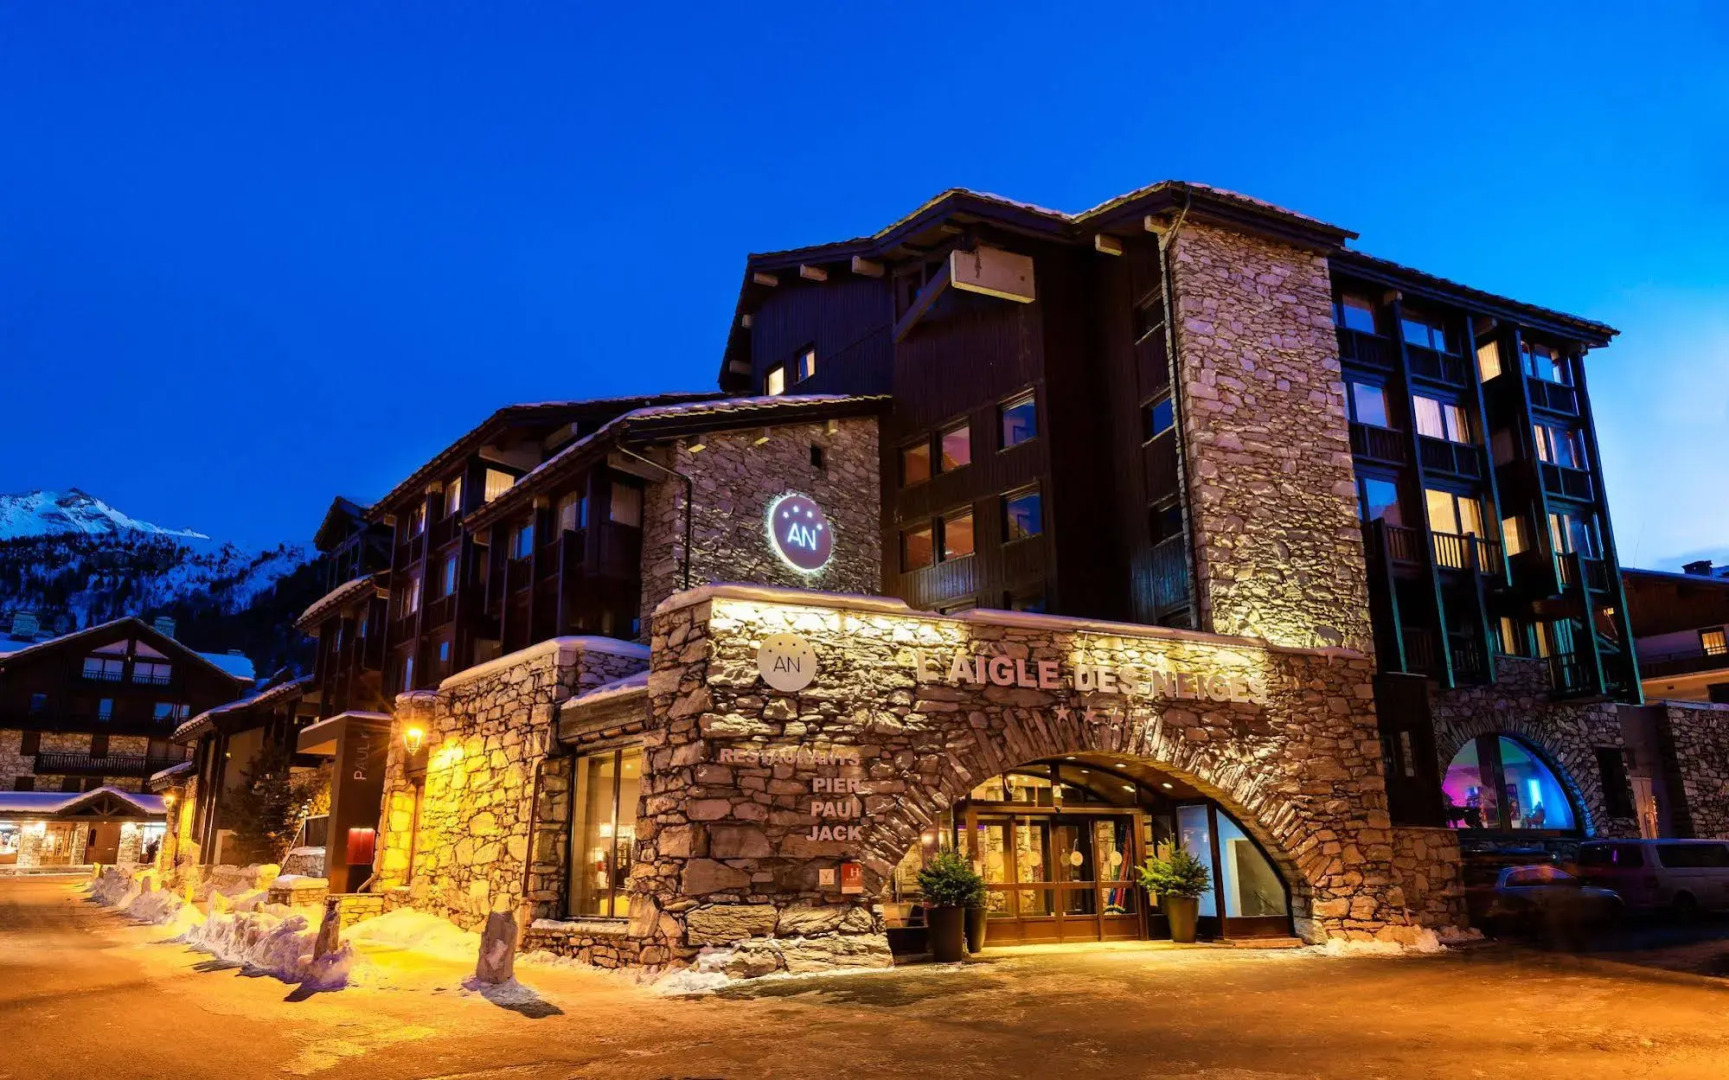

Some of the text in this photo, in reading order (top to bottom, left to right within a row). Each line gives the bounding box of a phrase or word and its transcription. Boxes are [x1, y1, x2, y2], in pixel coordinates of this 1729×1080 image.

[787, 522, 817, 551] AN
[773, 655, 800, 673] AN
[916, 650, 1268, 704] L'AIGLE DES NEIGES
[719, 748, 861, 766] RESTAURANTS
[812, 777, 862, 793] PIER
[810, 801, 861, 817] PAUL
[805, 825, 863, 842] JACK
